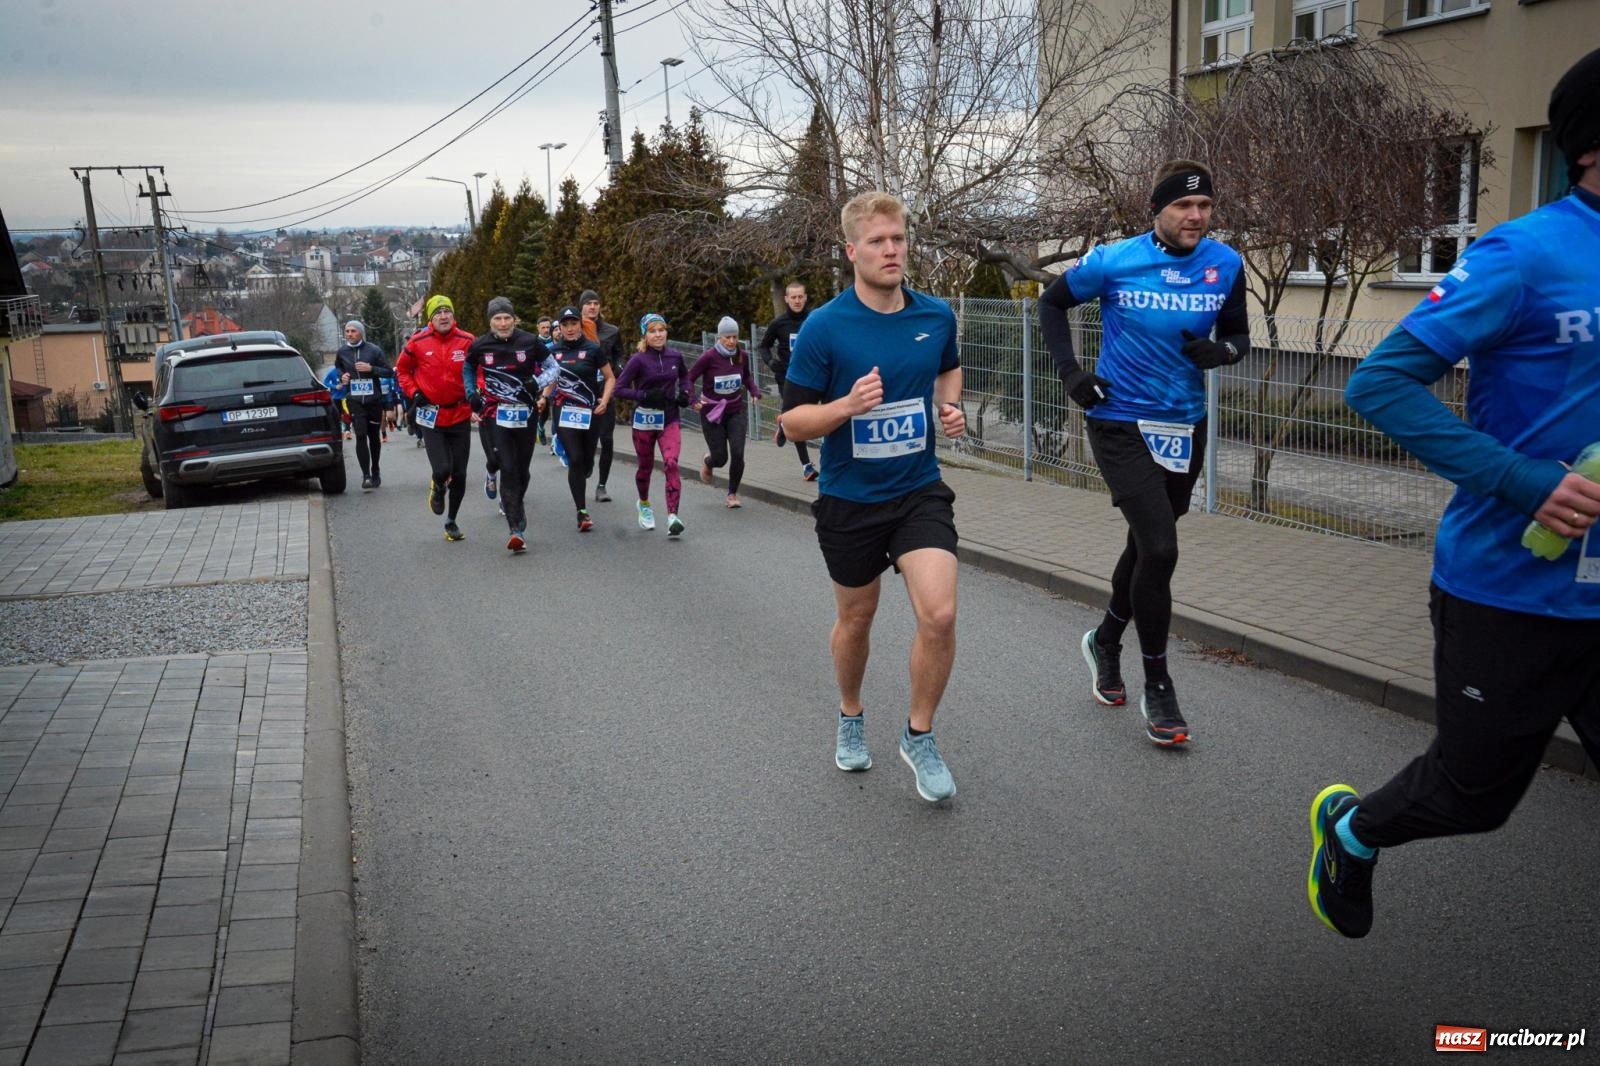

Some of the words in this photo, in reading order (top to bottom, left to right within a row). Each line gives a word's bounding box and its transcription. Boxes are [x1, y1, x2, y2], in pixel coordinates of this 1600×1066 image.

[1117, 290, 1226, 312] RUNNERS
[1555, 307, 1600, 343] R
[720, 381, 737, 390] 146
[246, 407, 275, 419] 1239P
[506, 410, 520, 421] 91
[568, 413, 583, 423] 68
[641, 415, 656, 424] 10
[866, 416, 915, 443] 104
[1148, 434, 1183, 458] 178
